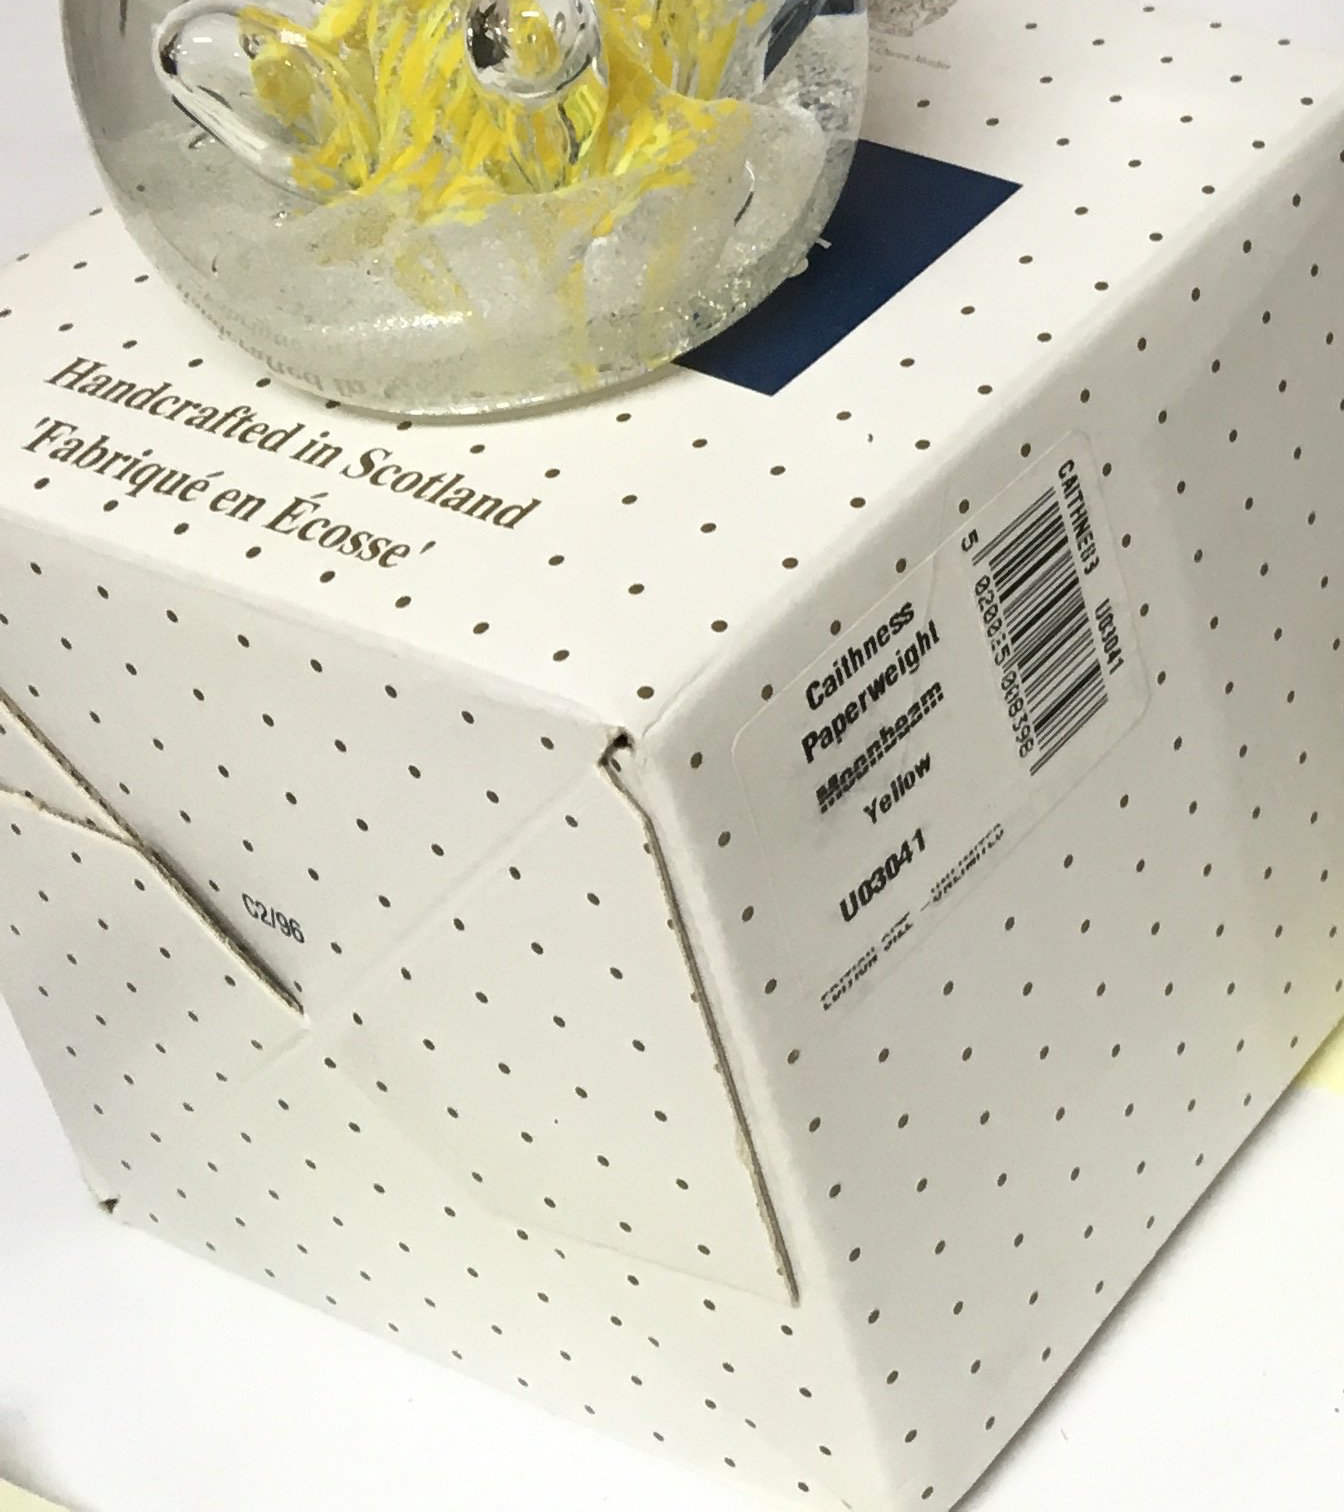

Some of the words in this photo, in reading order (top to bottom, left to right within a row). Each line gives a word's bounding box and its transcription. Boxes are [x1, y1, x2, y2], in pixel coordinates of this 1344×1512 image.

[21, 417, 225, 503] 'Fabriqué
[208, 487, 267, 523] en
[262, 492, 437, 569] Écosse'
[44, 357, 304, 454] Handcrafted
[289, 430, 345, 470] in
[340, 447, 541, 530] Scotland
[960, 529, 979, 552] 5
[801, 619, 940, 765] Paperweight
[804, 601, 916, 711] Caithness
[862, 752, 931, 825] Yellow
[241, 893, 305, 944] C2/96
[839, 827, 925, 923] U03041
